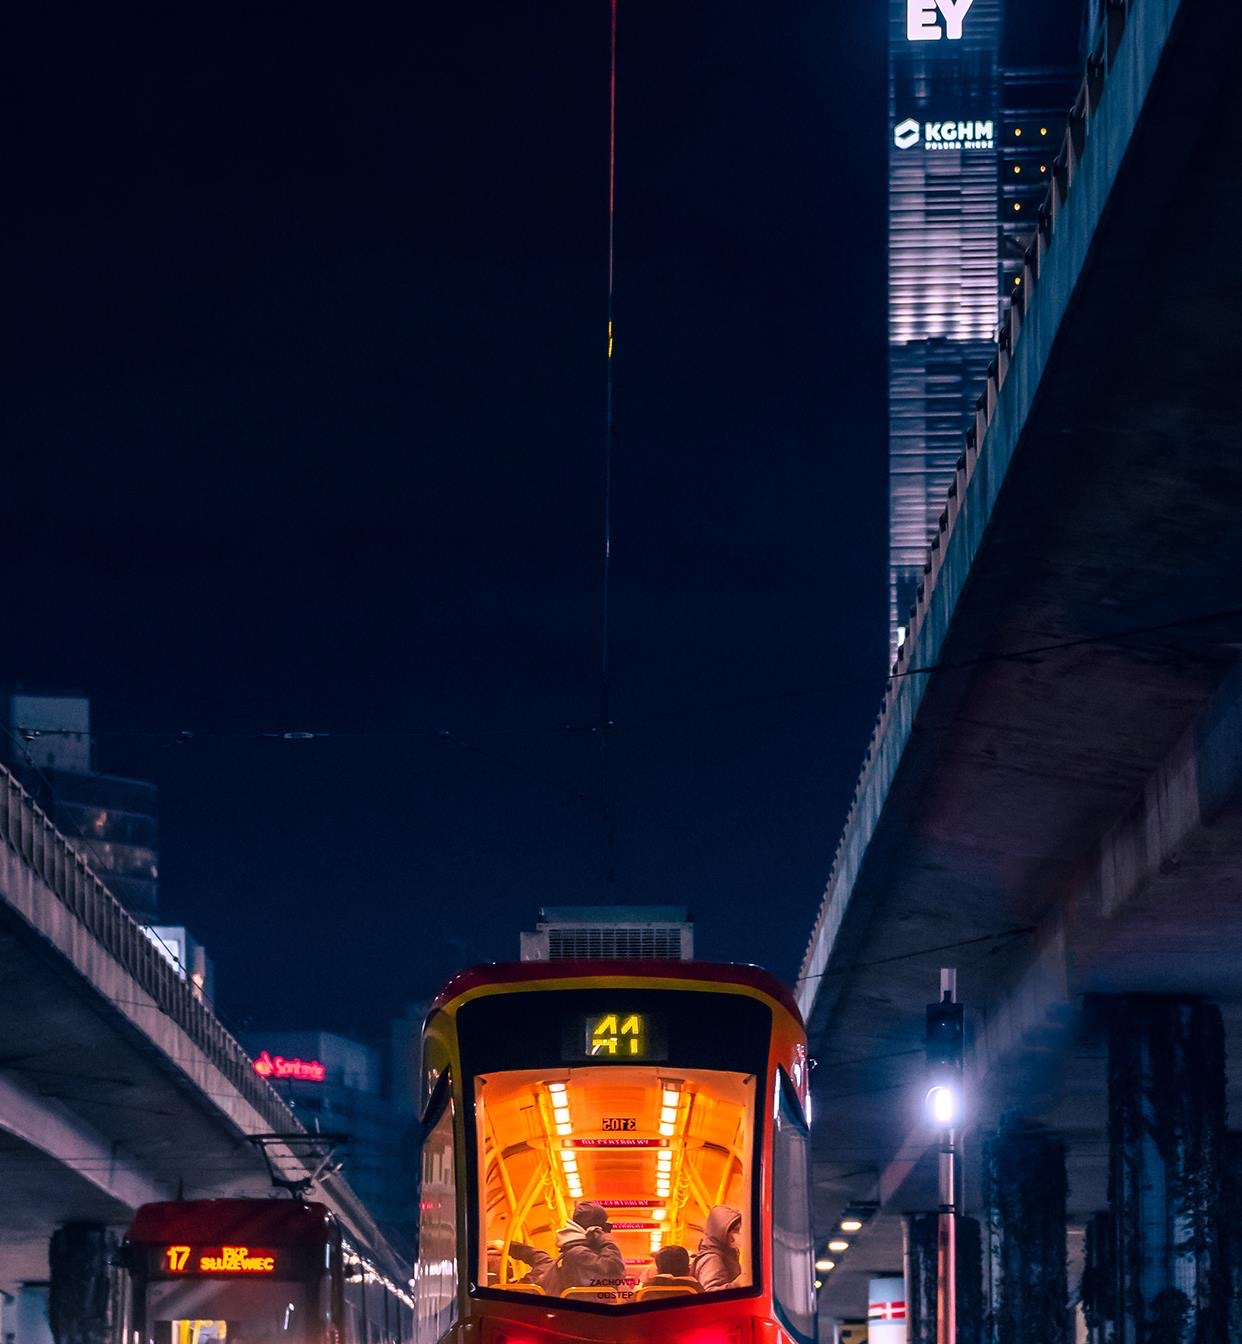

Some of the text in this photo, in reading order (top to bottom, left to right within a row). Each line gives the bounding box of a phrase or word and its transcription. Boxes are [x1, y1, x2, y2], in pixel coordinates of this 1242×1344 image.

[907, 0, 974, 41] EY
[925, 121, 993, 141] KGHM
[592, 1014, 639, 1055] 41
[166, 1246, 191, 1270] 17
